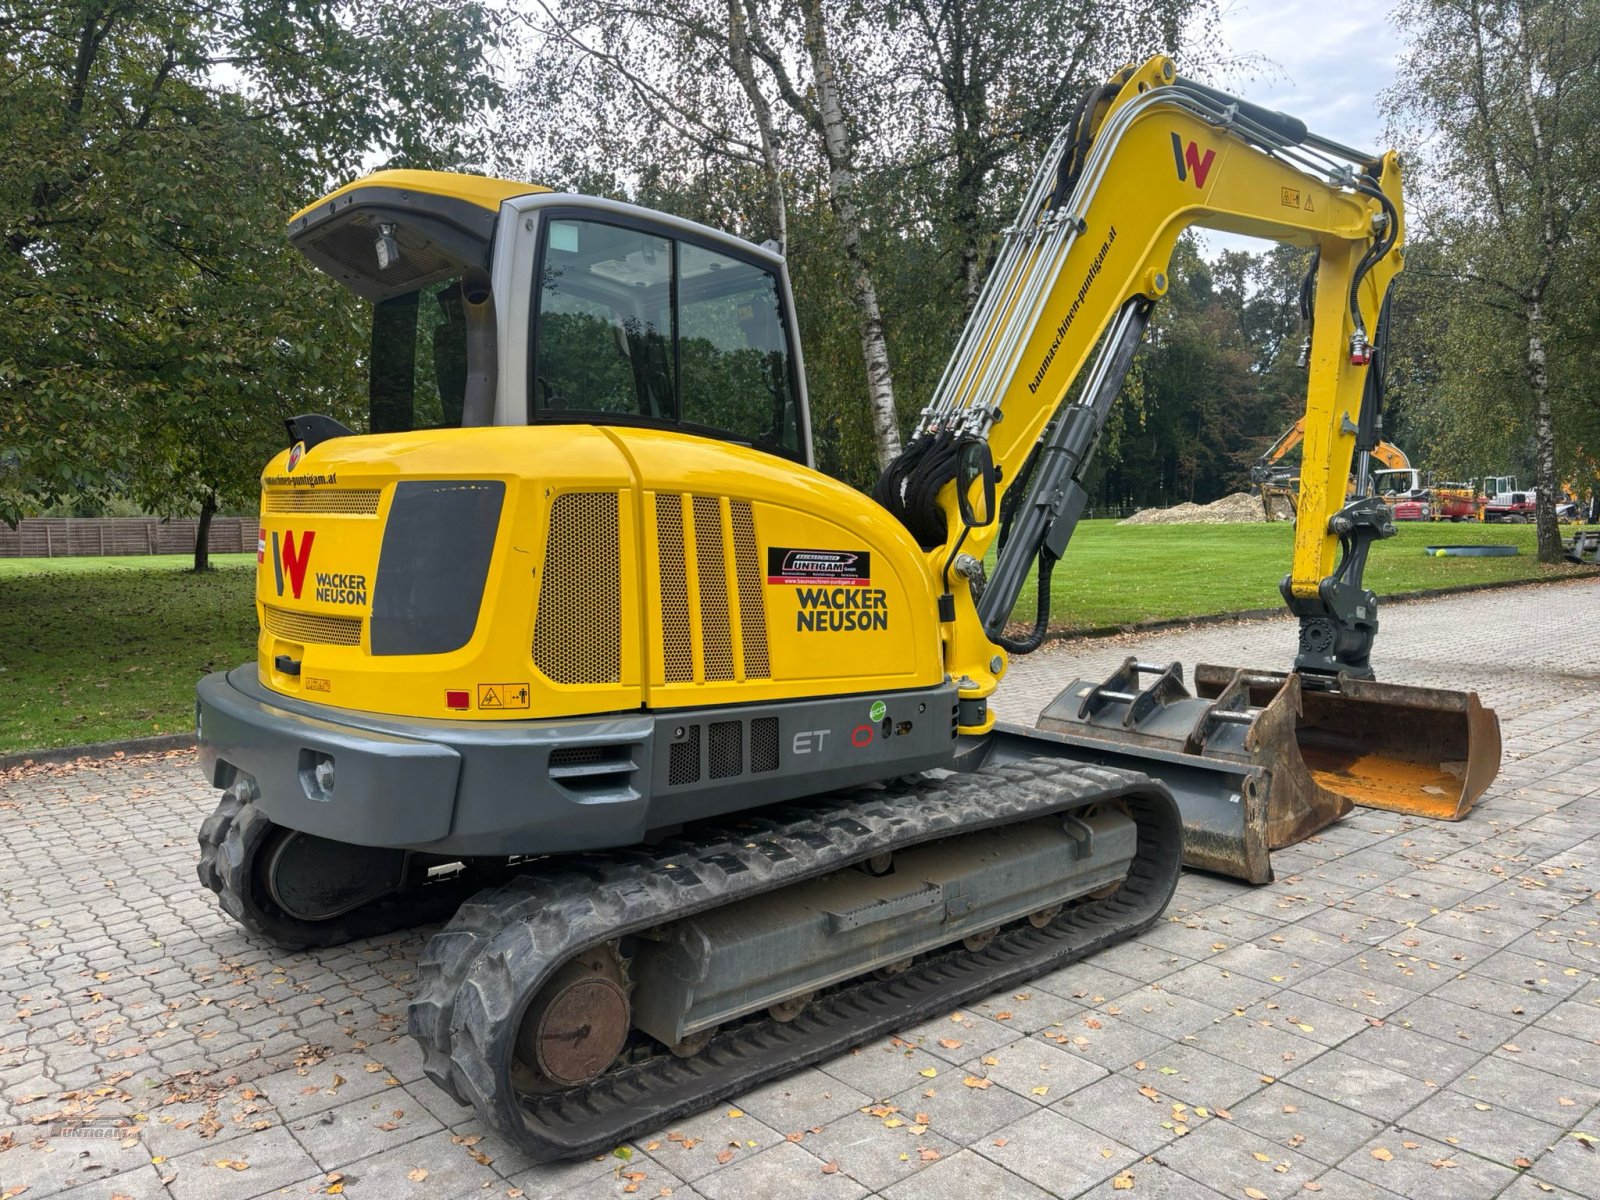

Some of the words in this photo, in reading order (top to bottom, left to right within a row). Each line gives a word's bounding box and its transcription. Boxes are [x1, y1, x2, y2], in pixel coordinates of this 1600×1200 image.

[1028, 225, 1118, 394] baumaschinen-puntigam.at
[315, 572, 366, 590] WACKER
[316, 588, 367, 605] NEUSON
[795, 588, 888, 610] WACKER
[796, 610, 888, 632] NEUSON
[870, 705, 886, 718] ECO
[792, 729, 831, 755] ET
